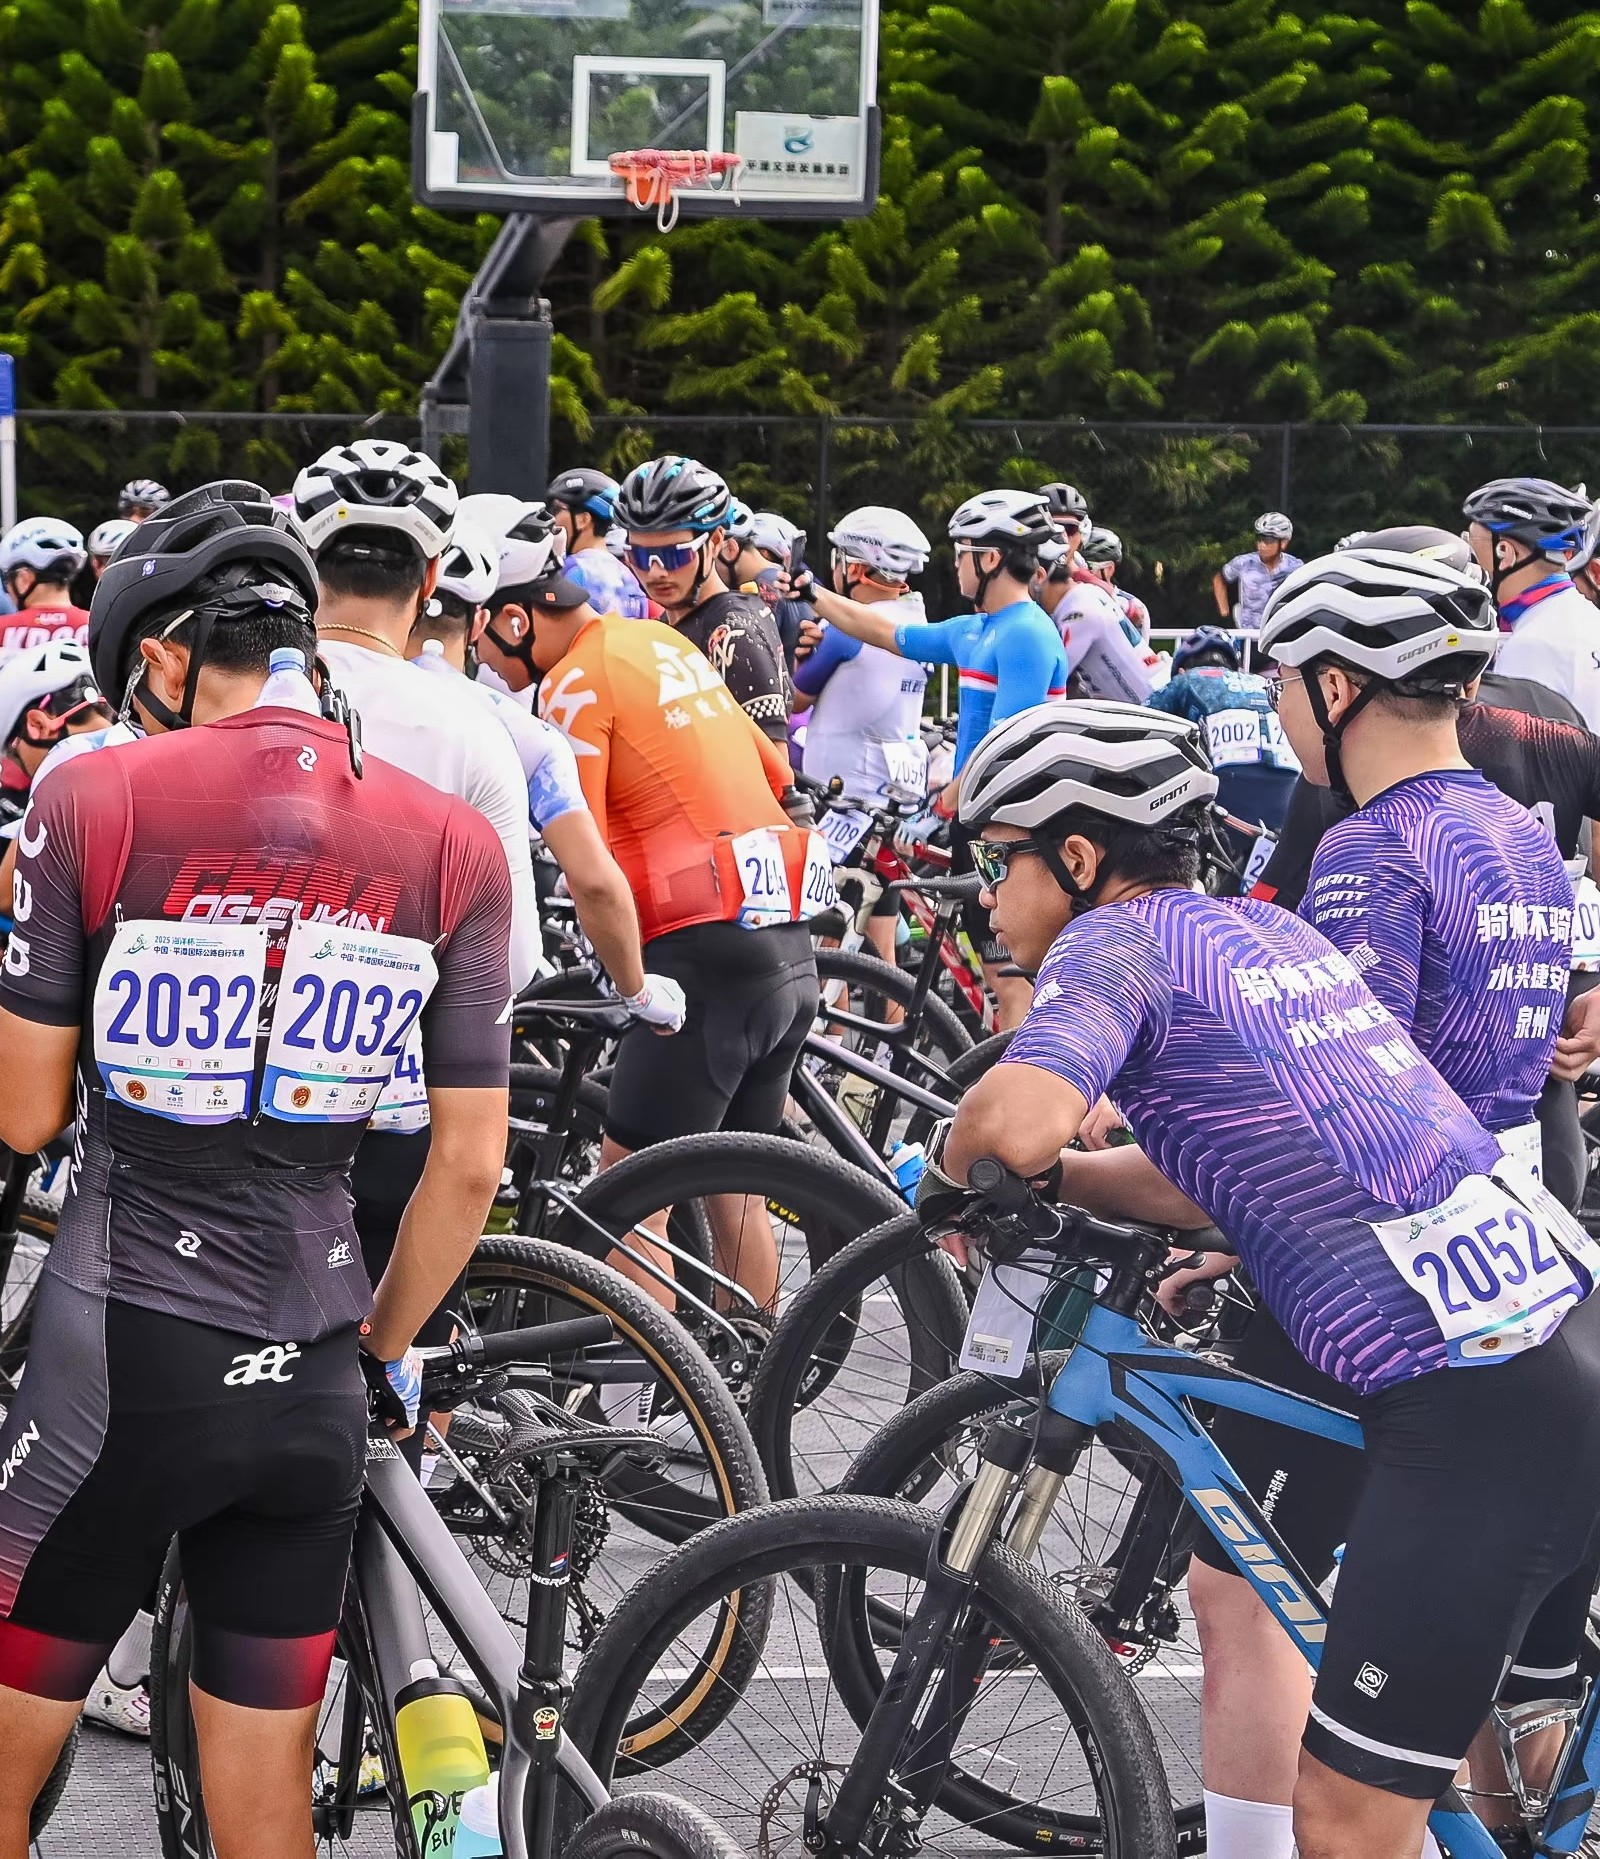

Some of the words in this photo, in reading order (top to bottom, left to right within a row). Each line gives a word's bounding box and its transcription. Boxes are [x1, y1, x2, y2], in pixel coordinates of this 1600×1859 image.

[1212, 722, 1255, 748] 2002
[1150, 780, 1190, 811] GIANT
[821, 816, 860, 847] 2109
[1314, 873, 1372, 893] GIANT
[1314, 890, 1371, 907] GIANT
[1315, 907, 1371, 925] GIANT
[155, 936, 171, 944] 2025
[342, 943, 357, 951] 2025
[106, 969, 256, 1050] 2032
[283, 973, 423, 1057] 2032
[1512, 1004, 1550, 1040] 泉州
[1412, 1208, 1558, 1315] 2052
[1197, 1488, 1330, 1643] GIA
